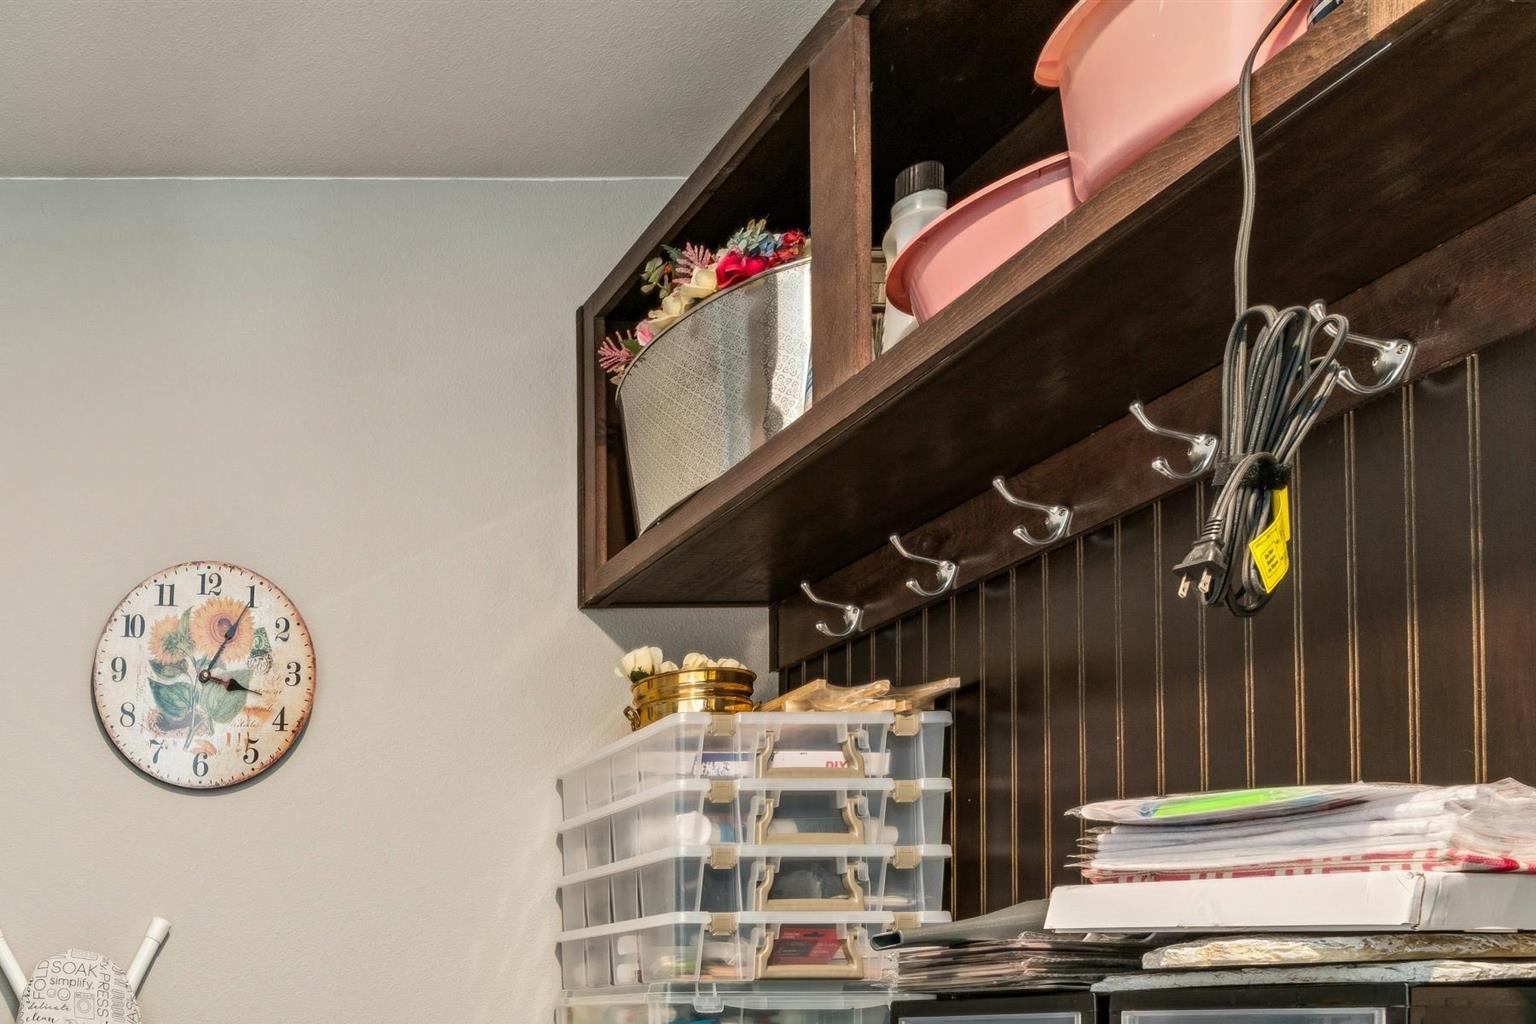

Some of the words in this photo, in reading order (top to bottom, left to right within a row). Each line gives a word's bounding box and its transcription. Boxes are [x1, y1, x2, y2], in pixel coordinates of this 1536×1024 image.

[154, 584, 178, 606] 11
[197, 573, 223, 596] 12
[248, 585, 259, 608] 1
[121, 615, 146, 638] 10
[275, 617, 290, 642] 2
[111, 657, 128, 682] 9
[285, 662, 301, 686] 3
[120, 702, 136, 727] 8
[272, 706, 288, 732] 4
[150, 739, 166, 764] 7
[243, 737, 259, 764] 5
[192, 752, 209, 777] 6
[33, 960, 49, 999] FOLD
[51, 961, 97, 978] SOAK
[50, 977, 94, 990] simplify.
[97, 972, 110, 1017] PRESS
[28, 1001, 71, 1011] delicate
[26, 1014, 57, 1023] clean
